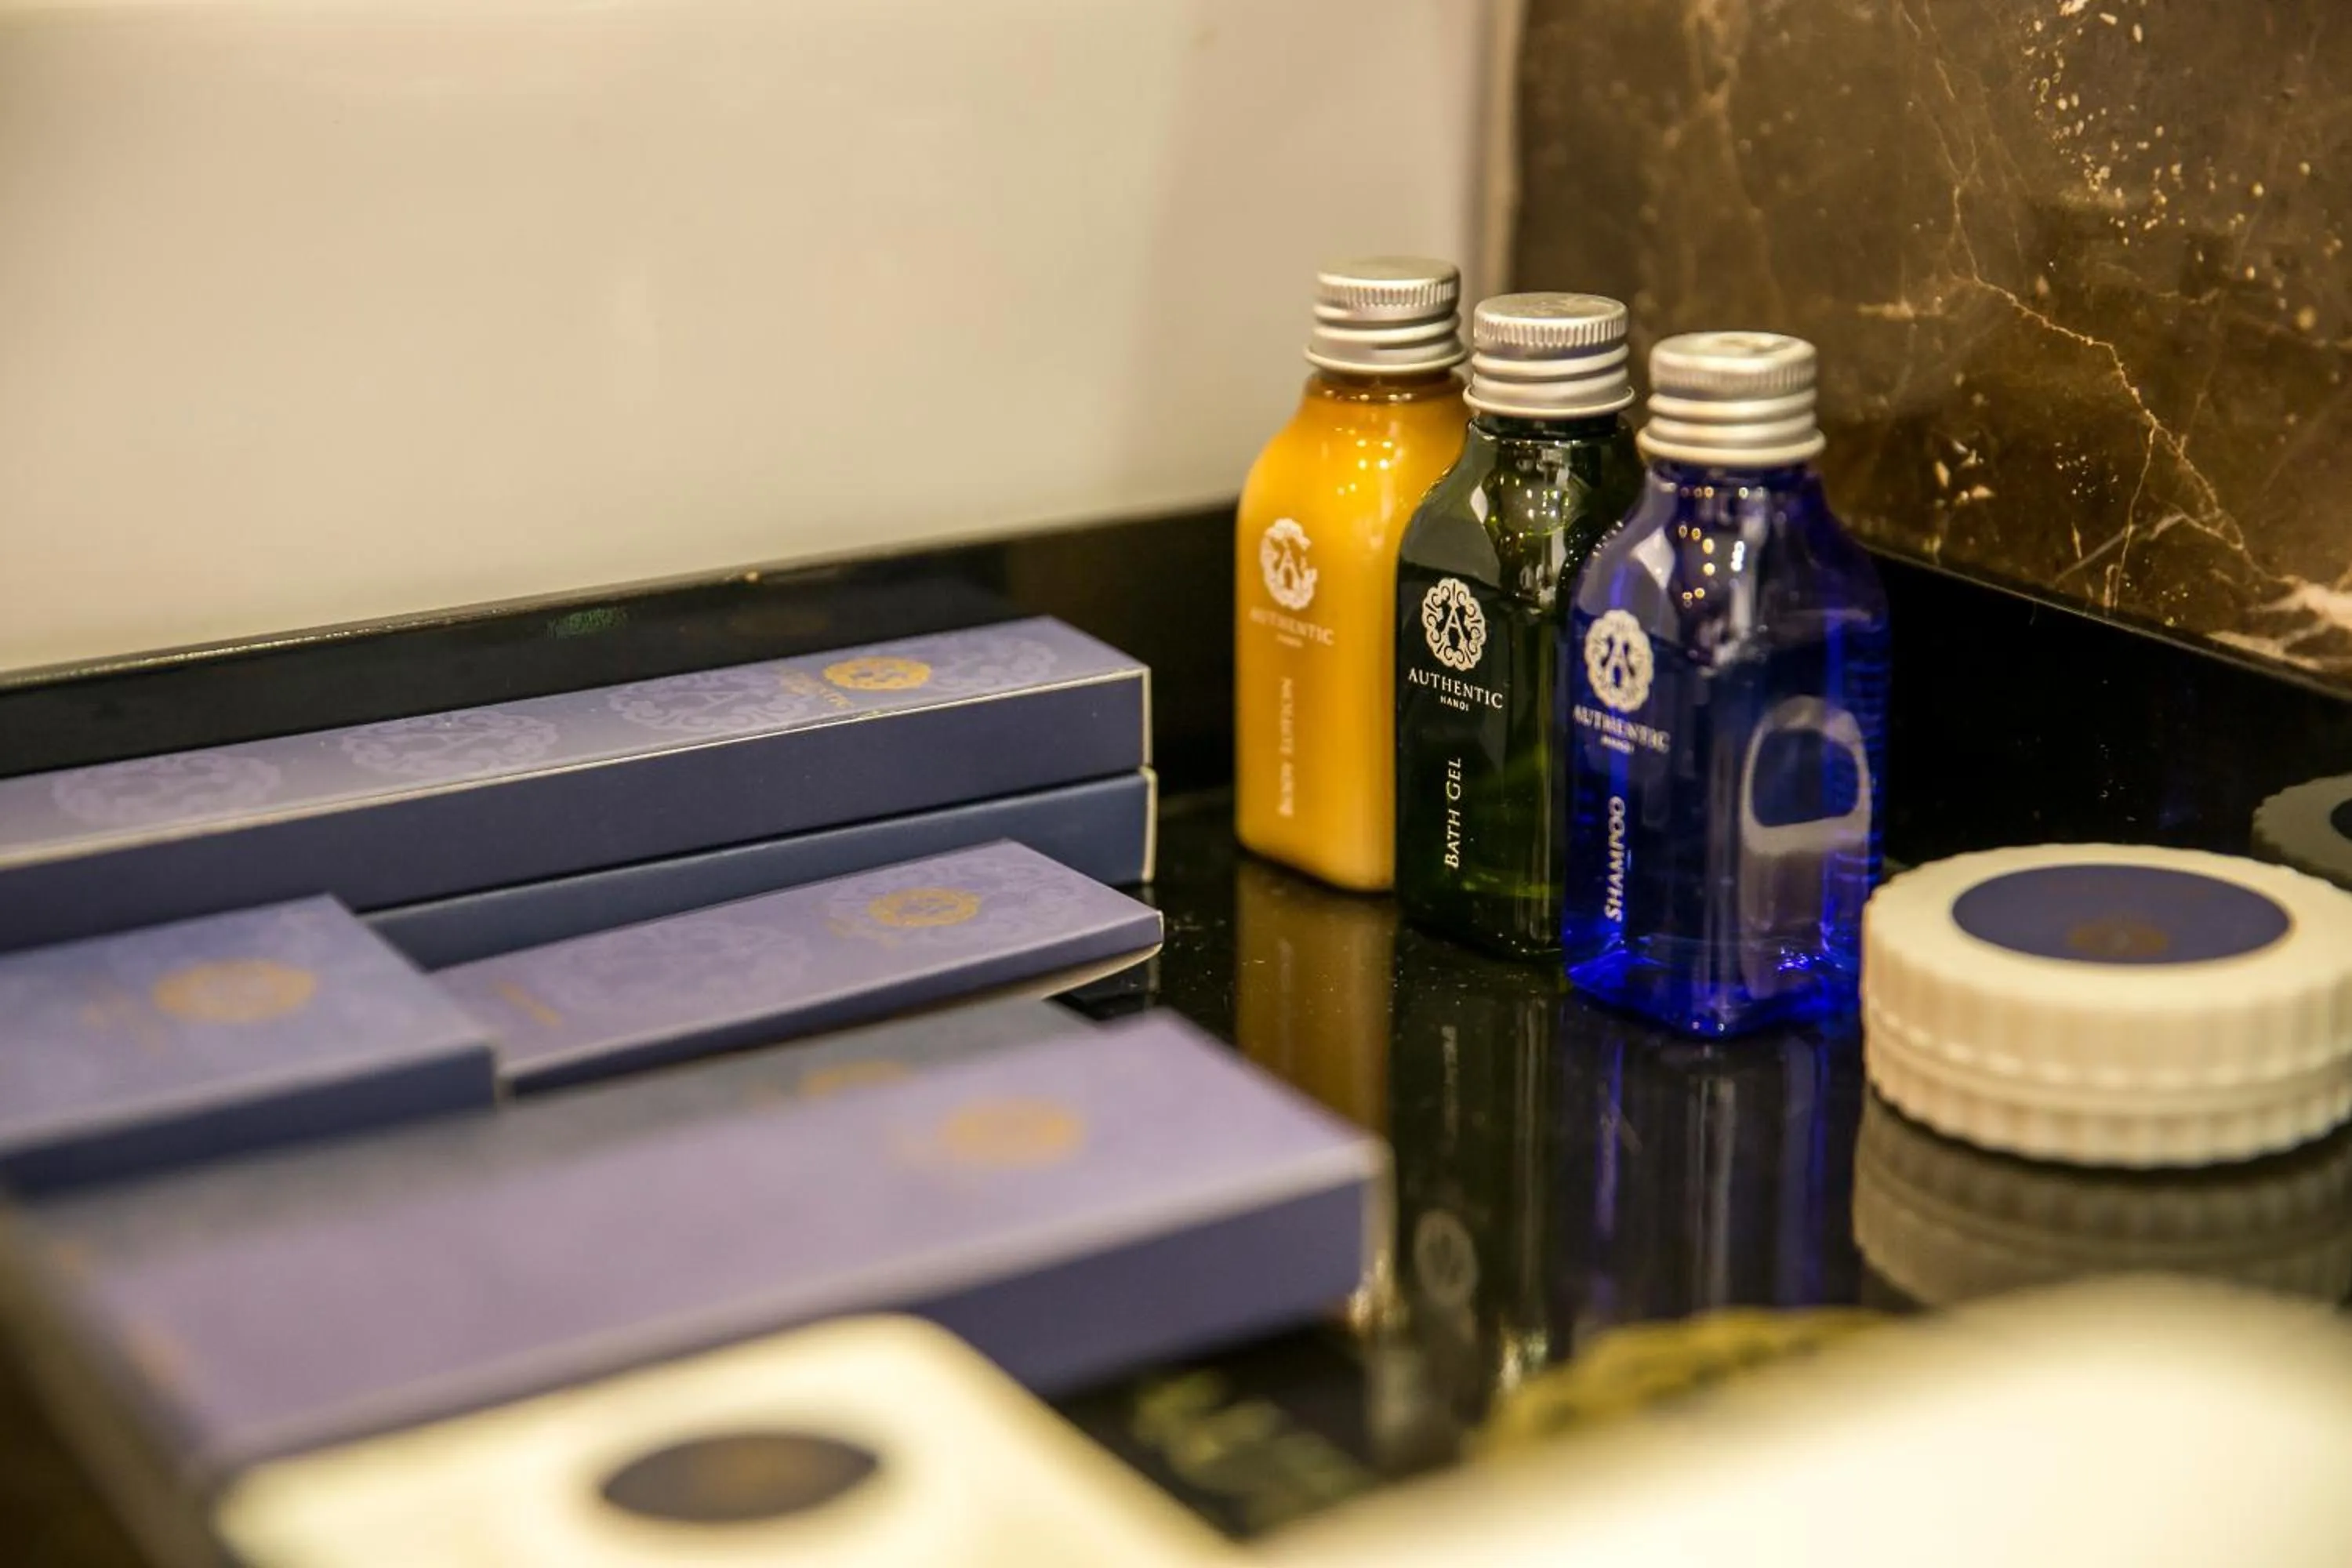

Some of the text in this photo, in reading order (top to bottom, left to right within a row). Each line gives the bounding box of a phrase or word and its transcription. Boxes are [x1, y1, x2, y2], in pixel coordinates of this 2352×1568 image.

[1409, 667, 1503, 709] AUTHENTIC
[1440, 695, 1469, 712] HANOI
[1445, 757, 1462, 869] BATH GEL
[1604, 796, 1625, 923] SHAMPOO
